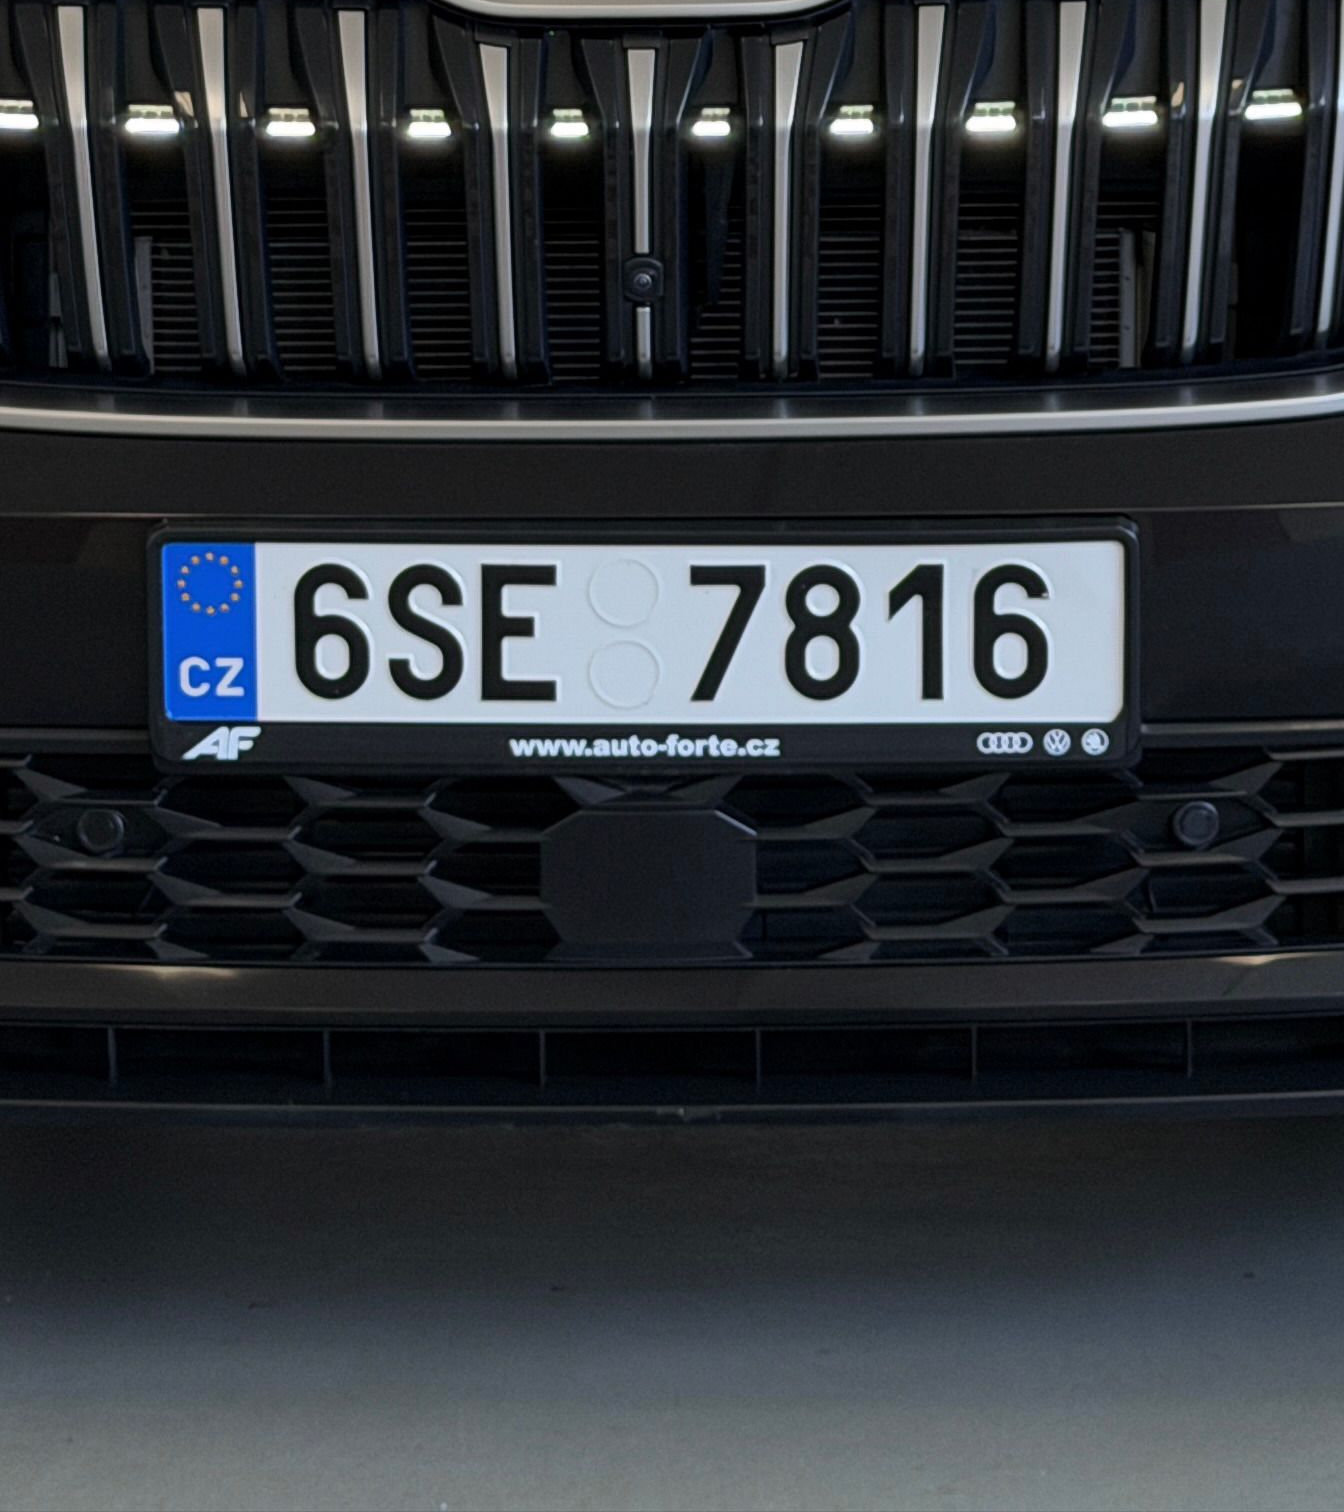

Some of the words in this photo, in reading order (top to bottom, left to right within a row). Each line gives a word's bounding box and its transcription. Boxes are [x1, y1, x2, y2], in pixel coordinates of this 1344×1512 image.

[293, 562, 557, 701] 6SE
[689, 563, 1050, 701] 7816
[178, 655, 246, 697] CZ
[181, 725, 262, 761] AF
[508, 734, 781, 758] www.auto-forte.cz
